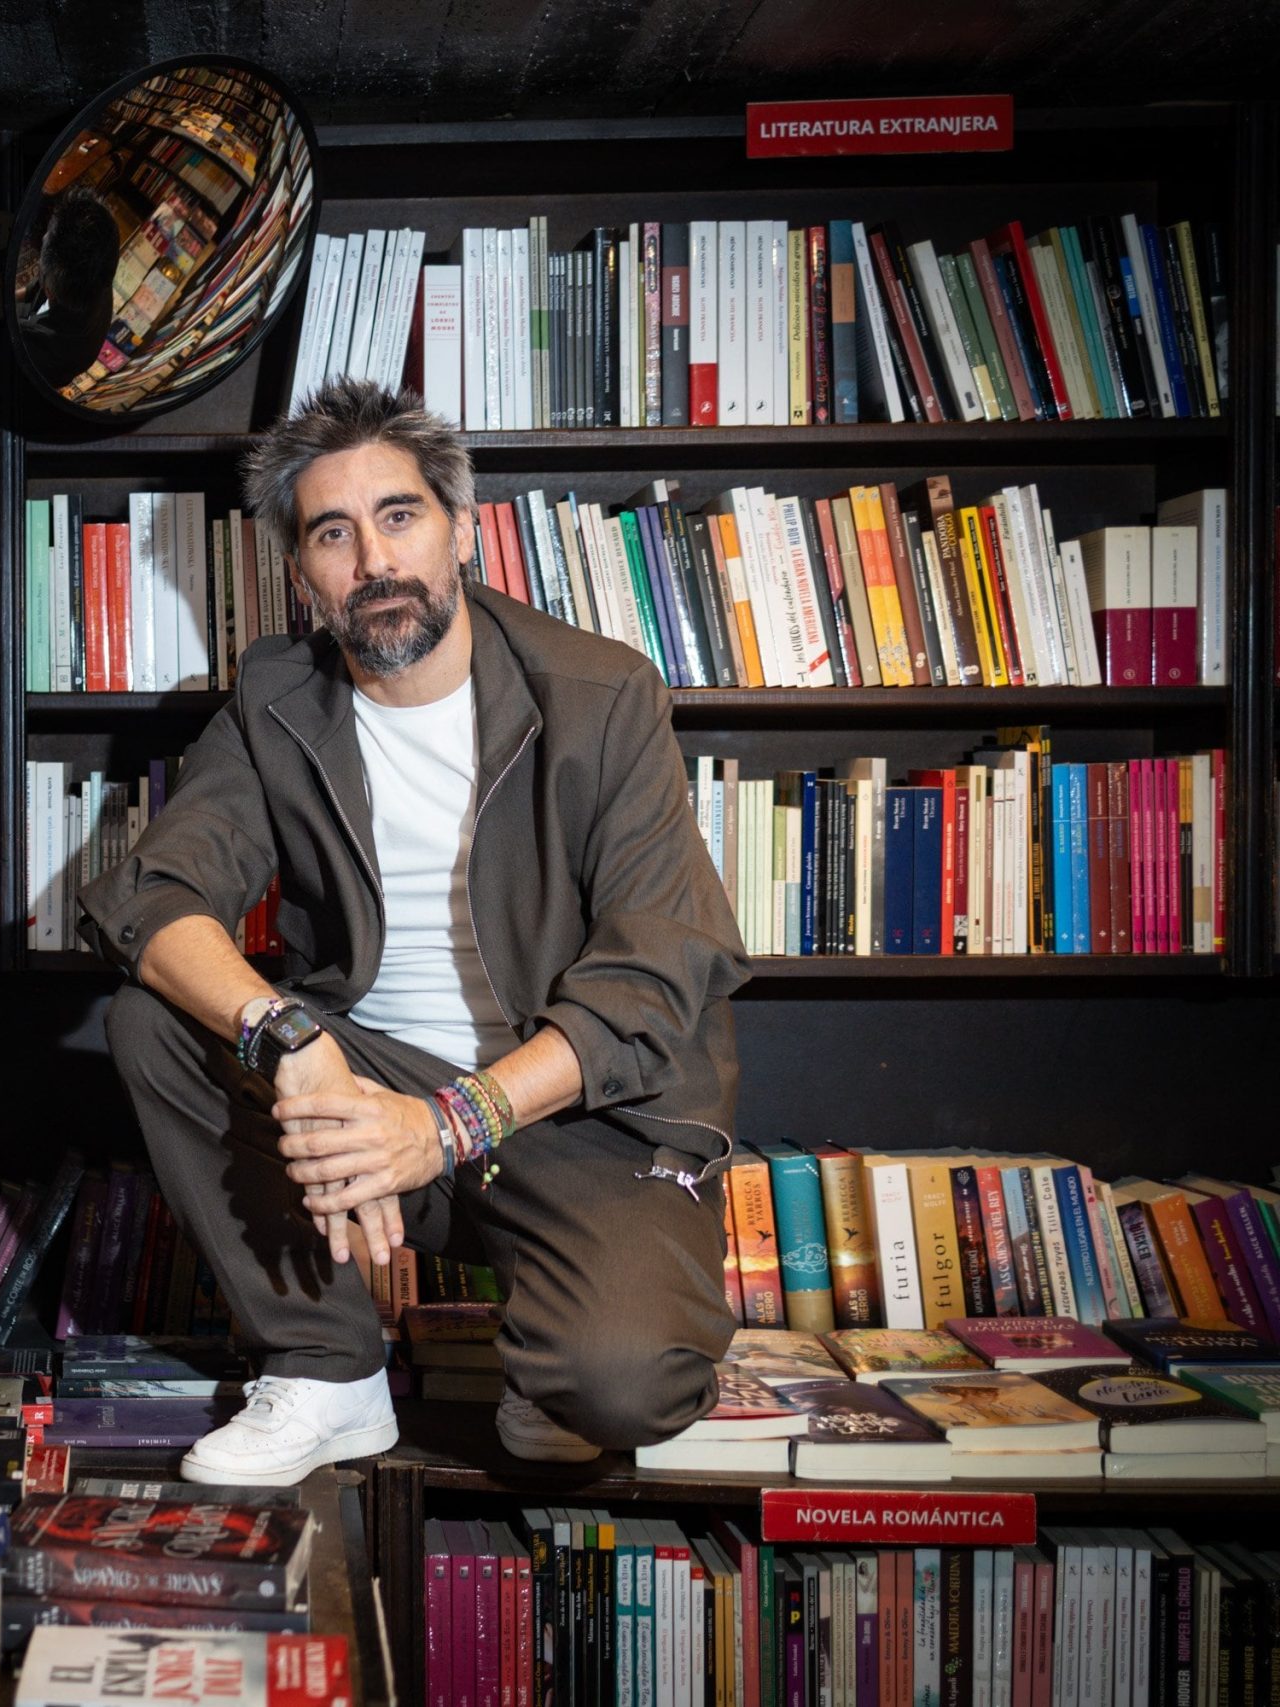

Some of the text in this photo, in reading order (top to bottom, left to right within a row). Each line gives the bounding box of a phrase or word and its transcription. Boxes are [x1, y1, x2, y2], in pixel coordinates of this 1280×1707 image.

[760, 115, 998, 138] LITERATURA EXTRANJERA
[793, 304, 801, 341] Delicioso
[782, 503, 798, 527] PHILIP
[943, 512, 957, 546] CONGO
[996, 502, 1011, 540] Farándula
[787, 528, 801, 546] ROTH
[936, 514, 951, 558] PANDORA
[618, 559, 629, 592] MAURICE
[793, 559, 807, 578] GRAN
[260, 577, 269, 612] GUATEMALA
[275, 576, 283, 611] GUATEMALA
[796, 578, 812, 605] NOVELA
[800, 606, 820, 644] AMERICANA
[744, 1180, 763, 1226] REBECCA YARROS
[839, 1176, 858, 1223] REBECCA YARROS
[1045, 1176, 1058, 1234] Tillie Cole
[1067, 1175, 1081, 1204] MUNDO
[1239, 1206, 1255, 1236] KELLEN
[988, 1189, 1013, 1291] LAS CADENAS DEL REY
[1078, 1227, 1089, 1251] LUGAR
[892, 1240, 908, 1301] furia
[932, 1232, 953, 1309] fulgor
[1081, 1251, 1095, 1286] NUESTRO
[764, 1291, 775, 1323] HIERRO
[858, 1289, 870, 1321] HIERRO
[1057, 1270, 1071, 1314] RECUERDOS
[755, 1302, 765, 1324] ALAS
[849, 1299, 859, 1321] ALAS
[138, 1438, 172, 1446] Terminal
[796, 1505, 1004, 1527] NOVELA ROMÁNTICA
[163, 1572, 224, 1596] SANGRE
[1176, 1567, 1191, 1607] CÍRCULO
[916, 1596, 927, 1635] fragilidad
[948, 1554, 960, 1654] MALDITA FORTUNA
[1178, 1622, 1191, 1663] ROMPER
[1219, 1647, 1230, 1682] HOOVER
[1243, 1645, 1255, 1680] HOOVER
[1178, 1669, 1191, 1707] HOOVER
